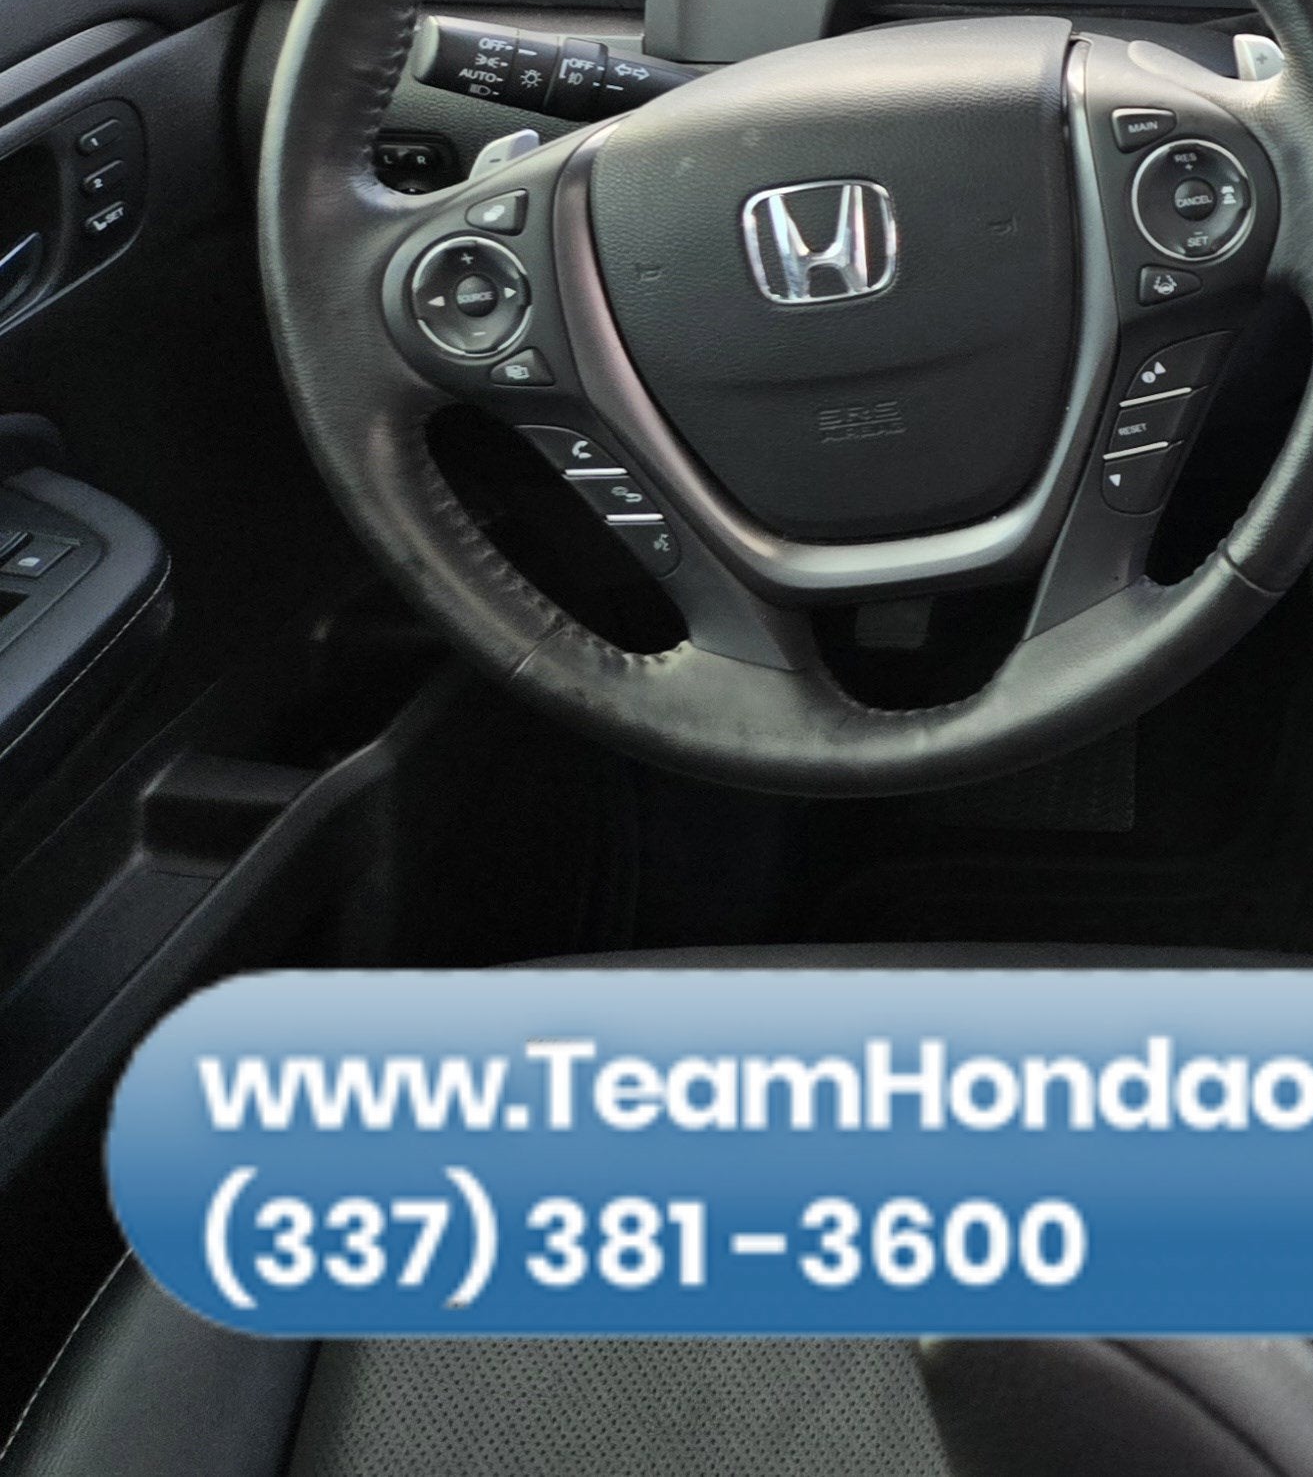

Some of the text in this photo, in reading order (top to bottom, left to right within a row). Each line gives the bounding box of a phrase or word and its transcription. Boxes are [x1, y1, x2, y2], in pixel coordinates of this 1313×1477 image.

[479, 37, 507, 51] OFF
[568, 57, 595, 71] OFF
[459, 67, 496, 83] AUTO
[1127, 119, 1159, 133] MAIN
[1174, 152, 1197, 164] RES
[1175, 194, 1213, 208] CANCEL
[1187, 235, 1209, 248] SET
[457, 290, 493, 304] SOURCE
[1118, 422, 1147, 436] RESET
